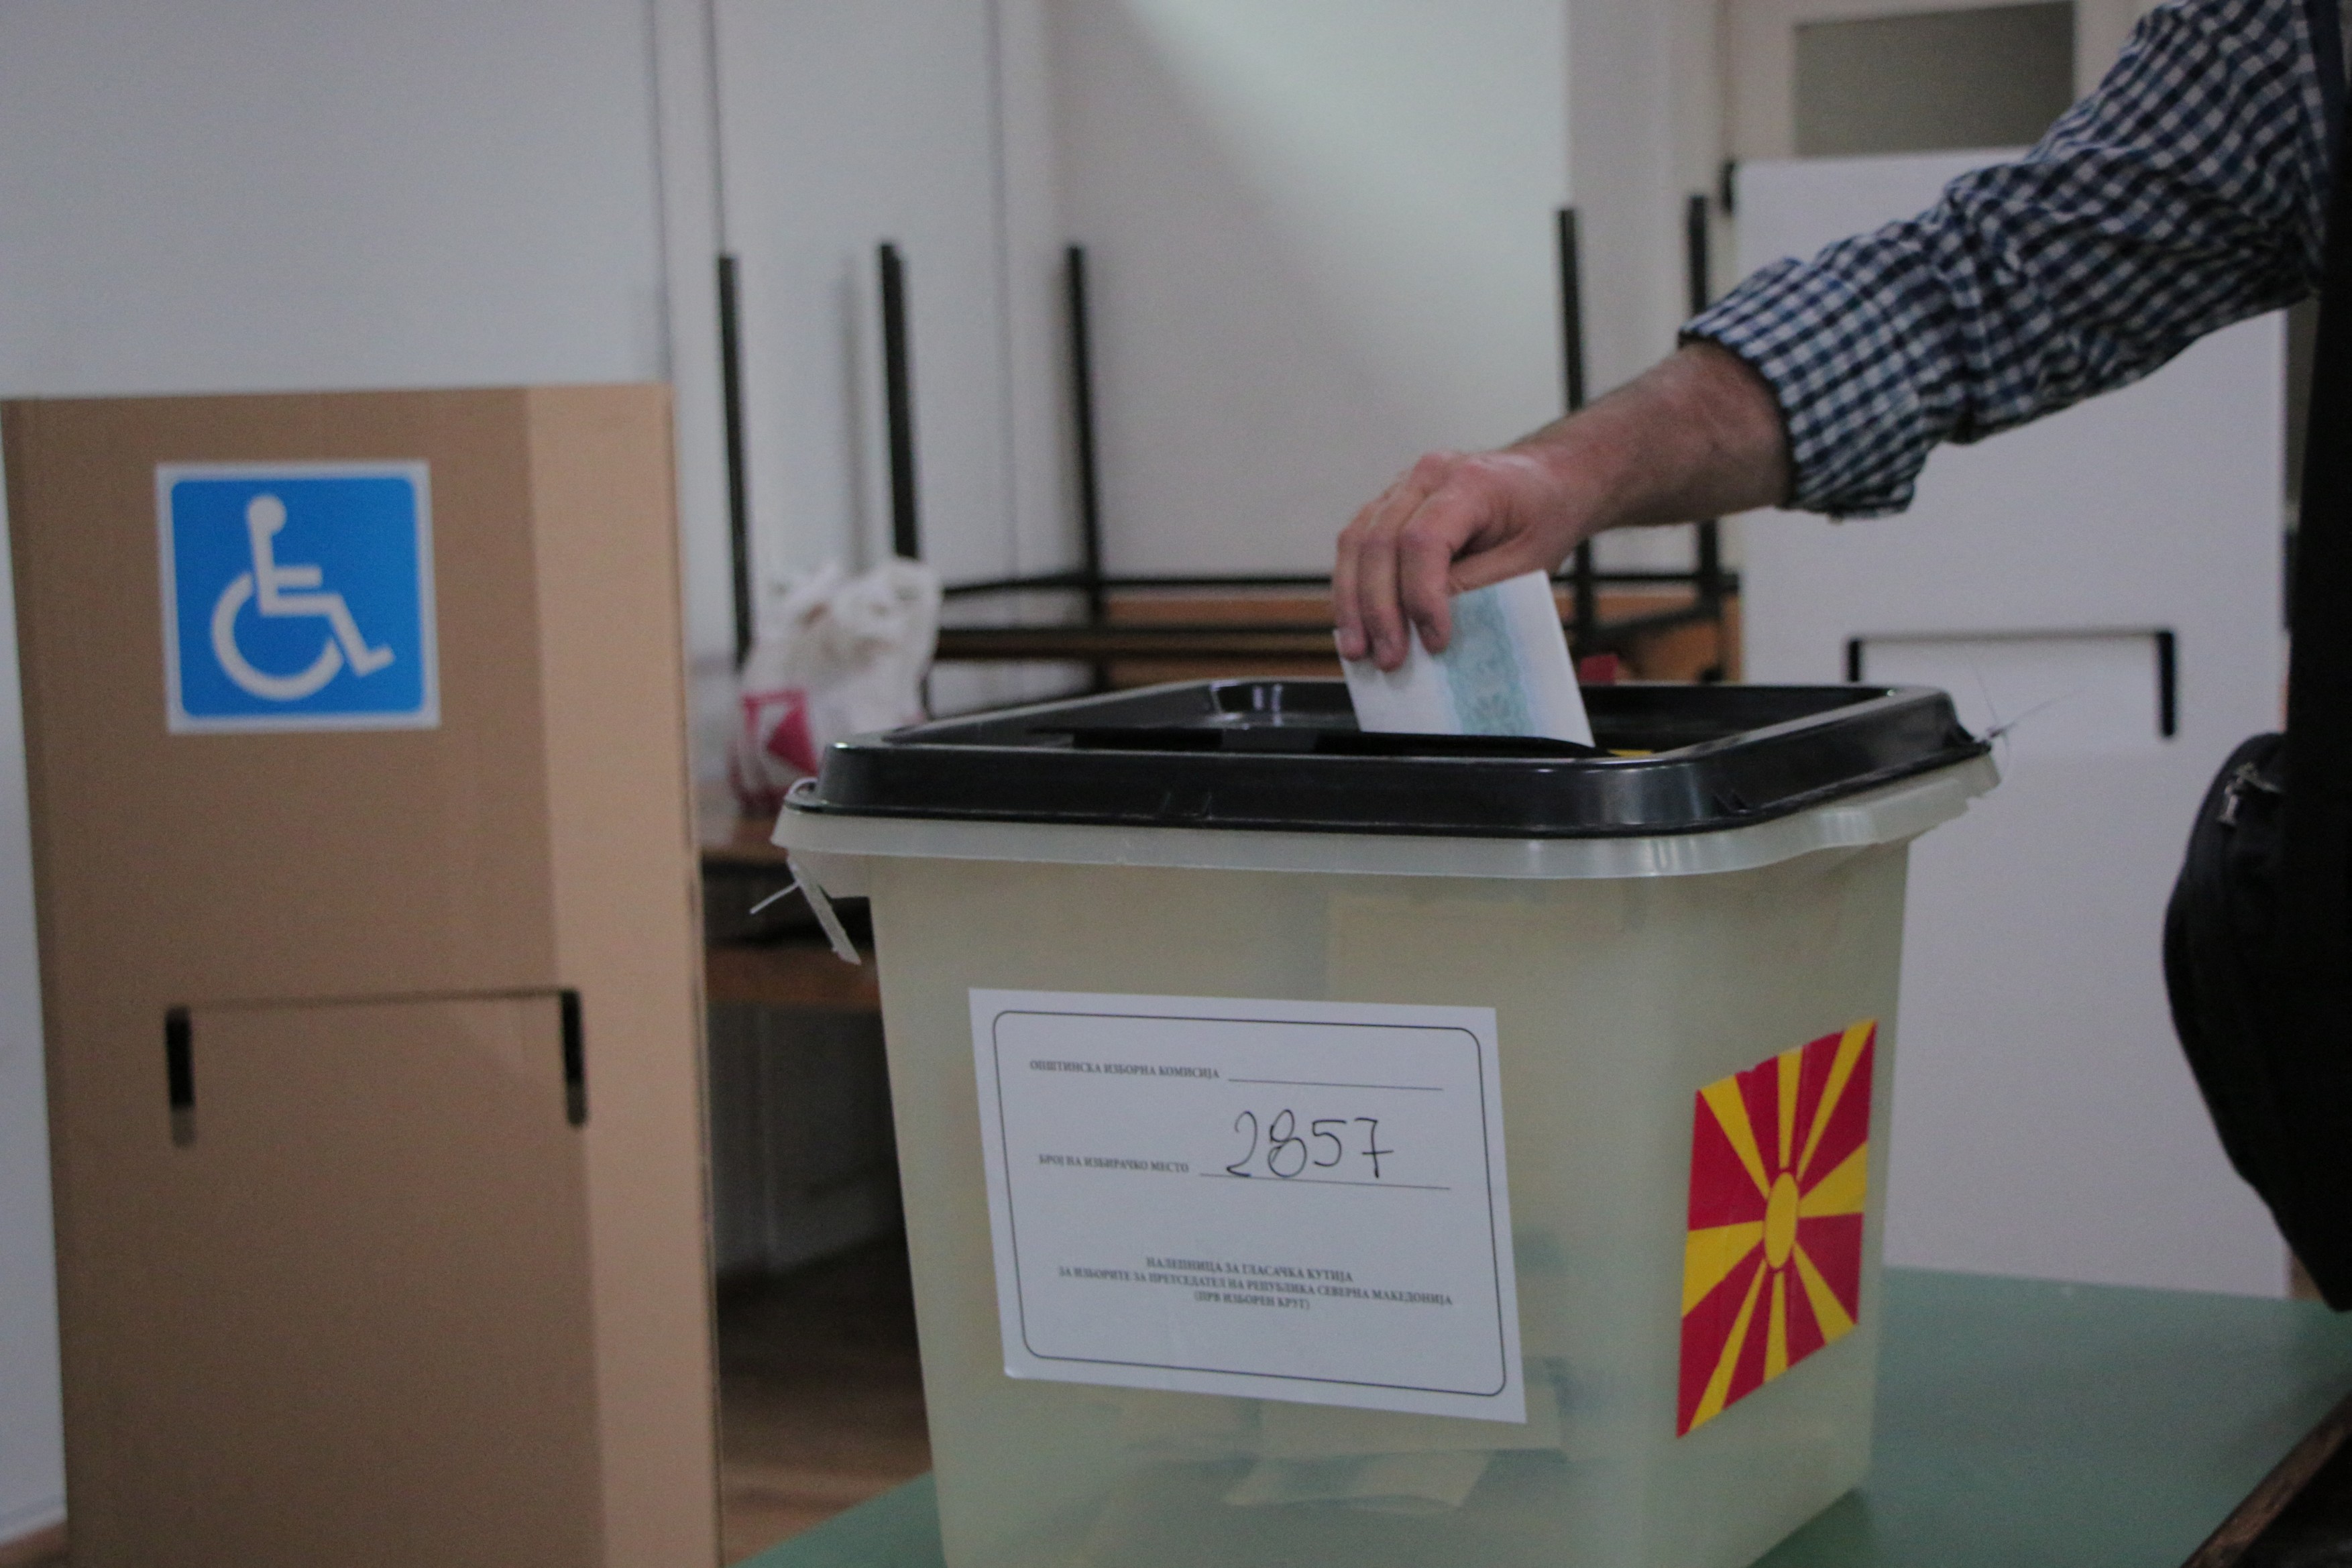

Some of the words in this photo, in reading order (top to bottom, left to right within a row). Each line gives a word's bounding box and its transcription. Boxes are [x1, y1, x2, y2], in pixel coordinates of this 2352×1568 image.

[1029, 1060, 1101, 1074] ОПШТИНСКА
[1104, 1062, 1156, 1076] ИЗБОРНА
[1159, 1065, 1220, 1079] КОМИСИЈА
[1226, 1109, 1394, 1178] 2857
[1039, 1154, 1064, 1167] БРОЈ
[1066, 1156, 1082, 1167] НА
[1084, 1156, 1149, 1171] ИЗБИРАЧКО
[1150, 1160, 1190, 1173] МЕСТО
[1146, 1256, 1223, 1272] НАЛЕПНИЦА
[1225, 1262, 1239, 1274] ЗА
[1241, 1263, 1304, 1279] ГЛАСАЧКА
[1306, 1268, 1354, 1283] КУТИЈА
[1058, 1266, 1072, 1278] ЗА
[1074, 1268, 1130, 1282] ИЗБОРИТЕ
[1133, 1272, 1147, 1282] ЗА
[1148, 1273, 1226, 1288] ПРЕТСЕДАТЕЛ
[1228, 1278, 1244, 1290] НА
[1246, 1279, 1315, 1295] РЕПУБЛИКА
[1317, 1284, 1369, 1300] СЕВЕРНА
[1372, 1289, 1453, 1306] МАКЕДОНИЈА
[1223, 1293, 1276, 1306] ИЗБОРЕН
[1277, 1297, 1310, 1310] КРУГ)
